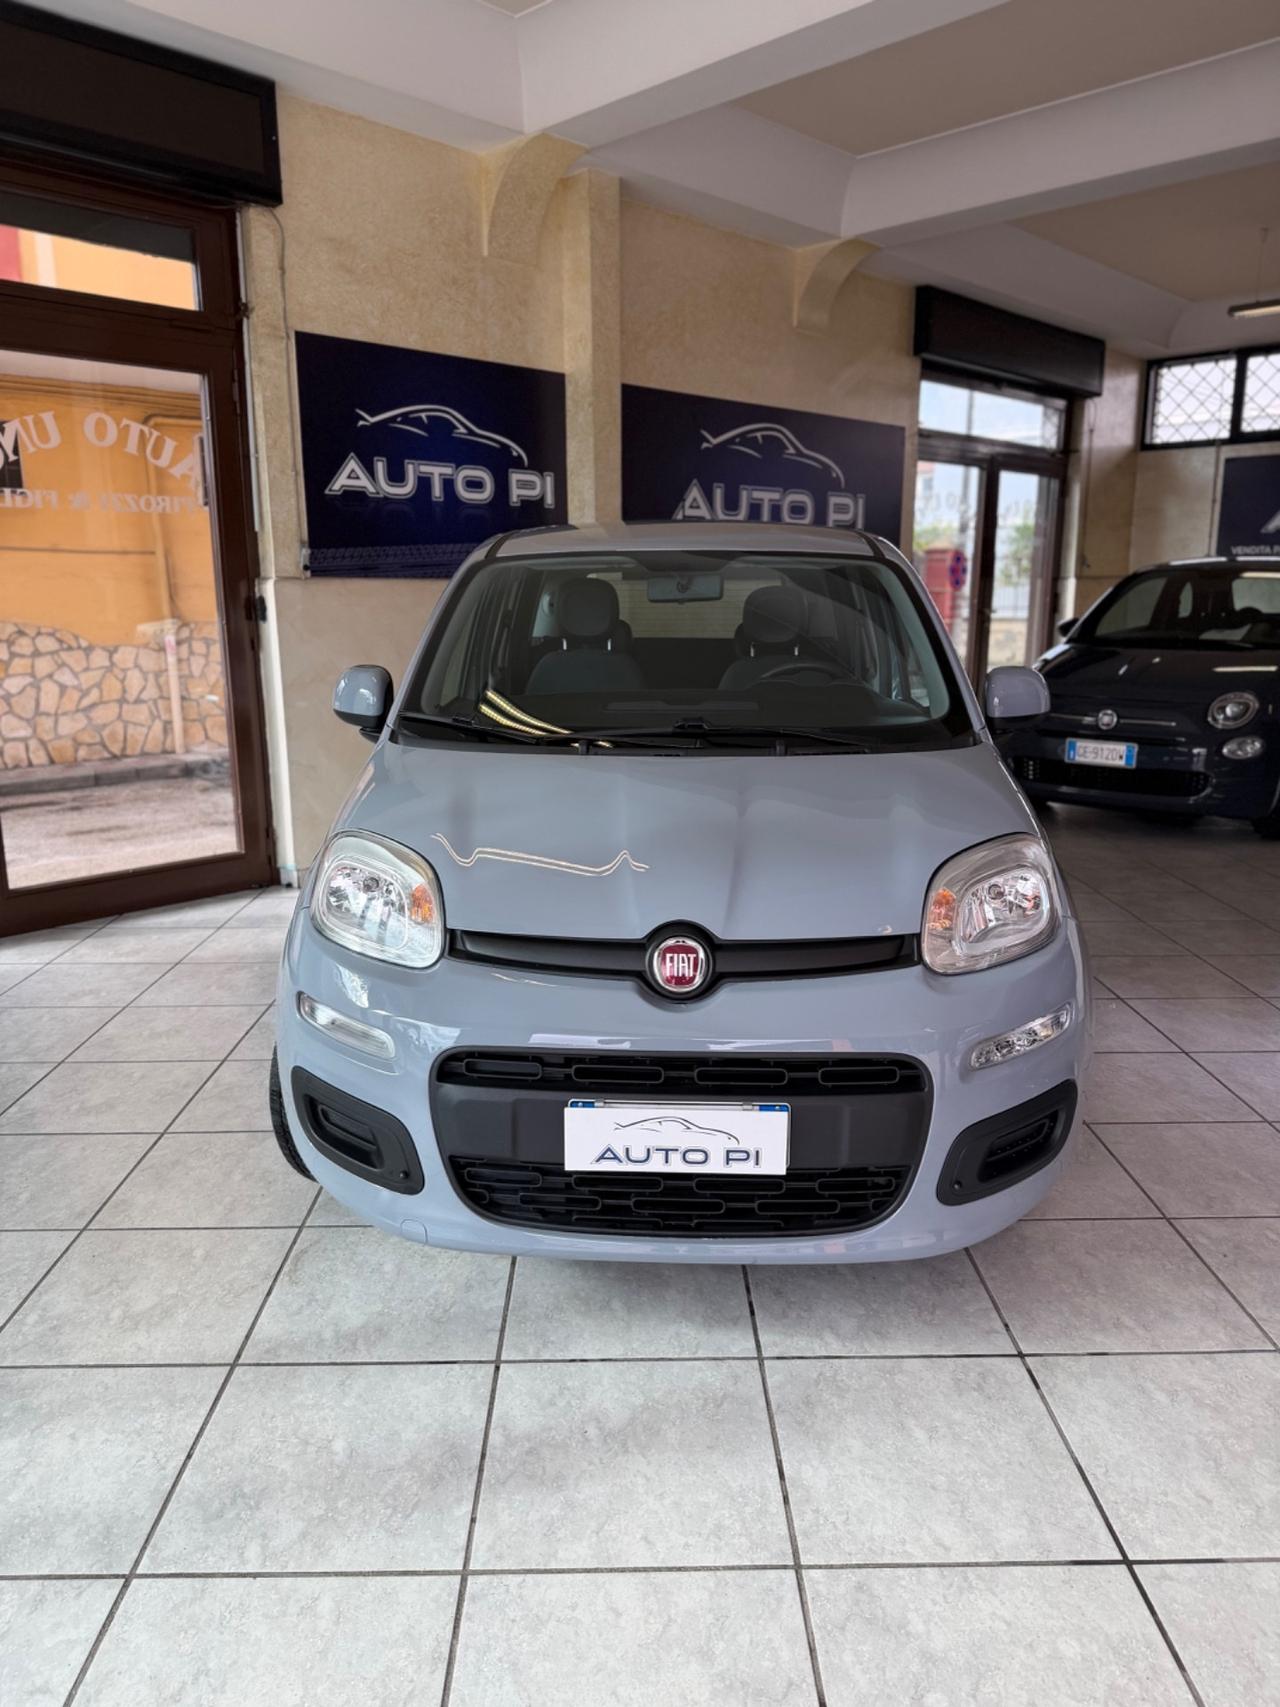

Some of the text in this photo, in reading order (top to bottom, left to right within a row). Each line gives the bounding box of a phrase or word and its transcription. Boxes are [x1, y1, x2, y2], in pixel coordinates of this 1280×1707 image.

[324, 452, 555, 508] AUTO PI
[671, 478, 815, 524] AUTO
[827, 491, 866, 531] PI
[665, 953, 697, 977] FIAT
[591, 1144, 763, 1168] AUTO PI
